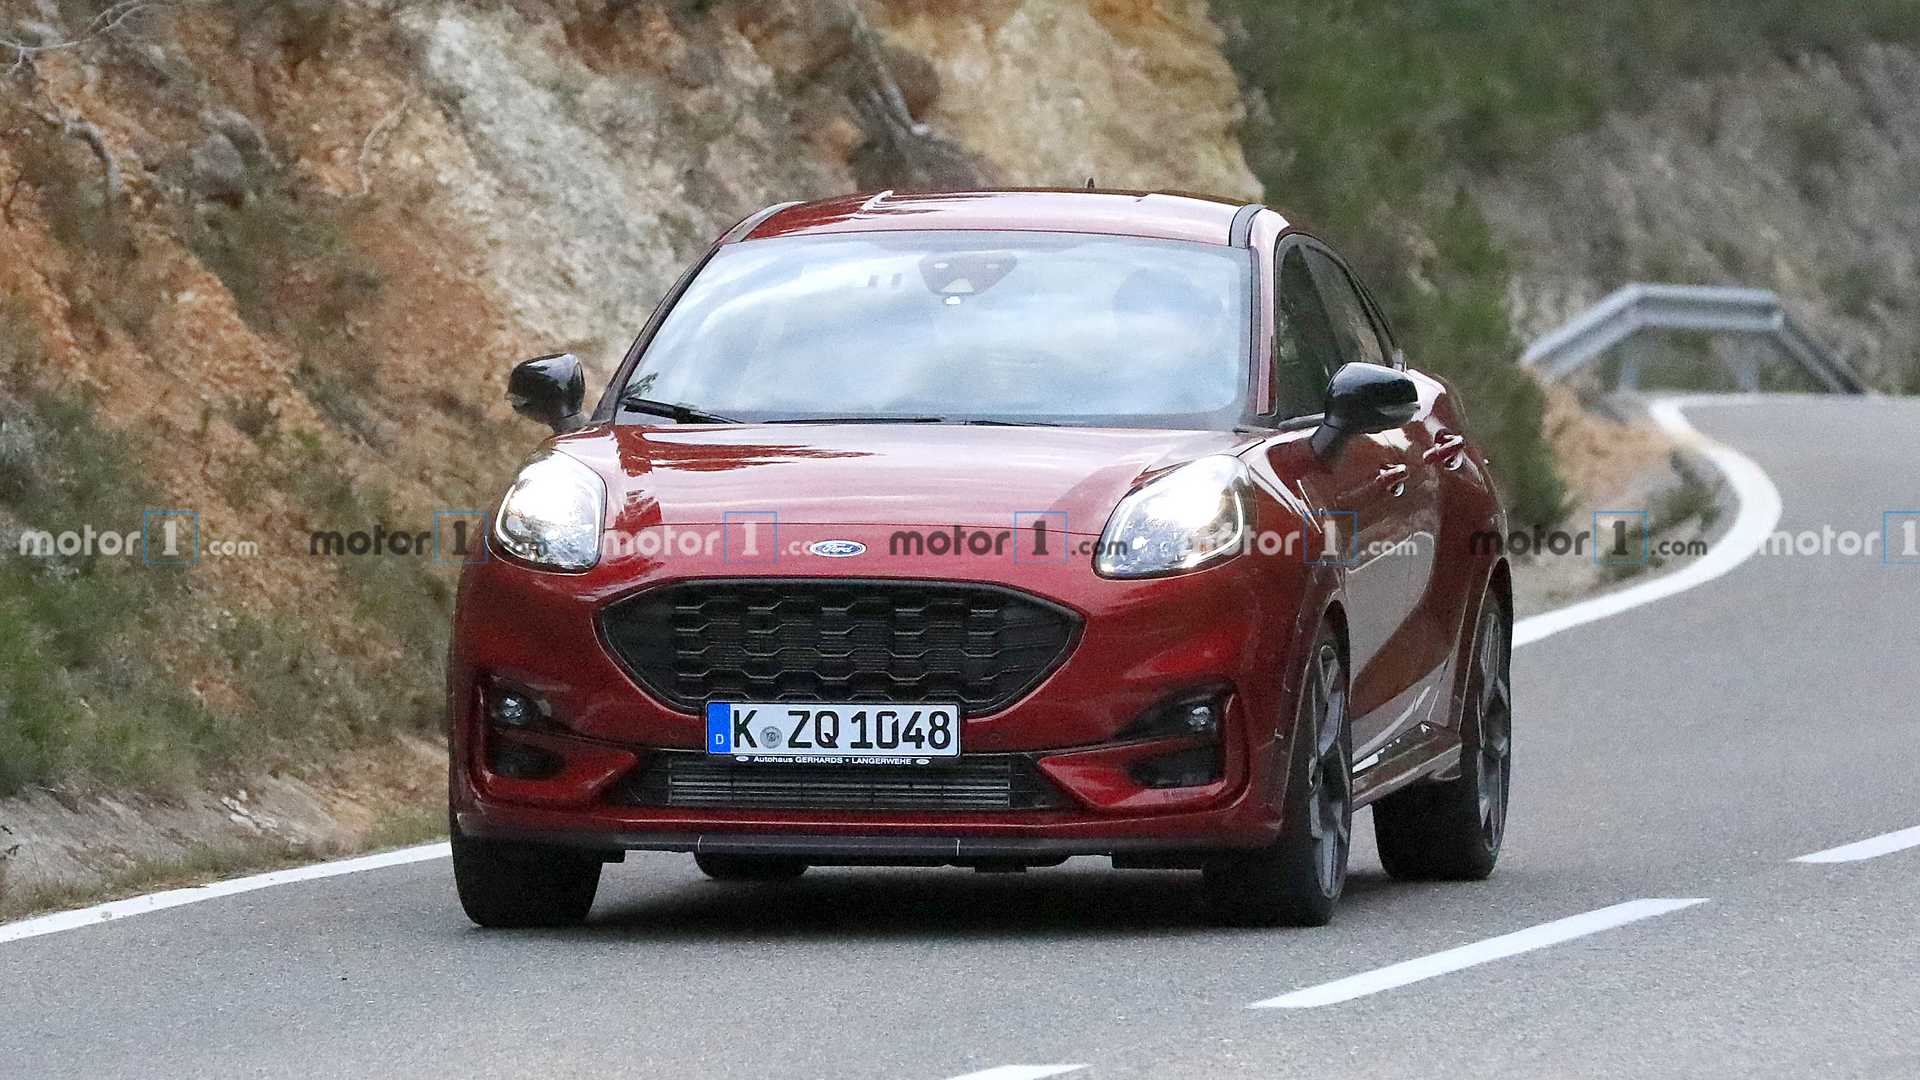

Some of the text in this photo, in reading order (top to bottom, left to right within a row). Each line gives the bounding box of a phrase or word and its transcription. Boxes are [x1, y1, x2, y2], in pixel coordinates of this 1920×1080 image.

[733, 710, 951, 749] K ZQ 1048
[715, 734, 724, 744] D
[753, 755, 793, 764] Autohaus
[795, 756, 843, 765] GERHARDS
[851, 757, 912, 766] LANGERWEHE
